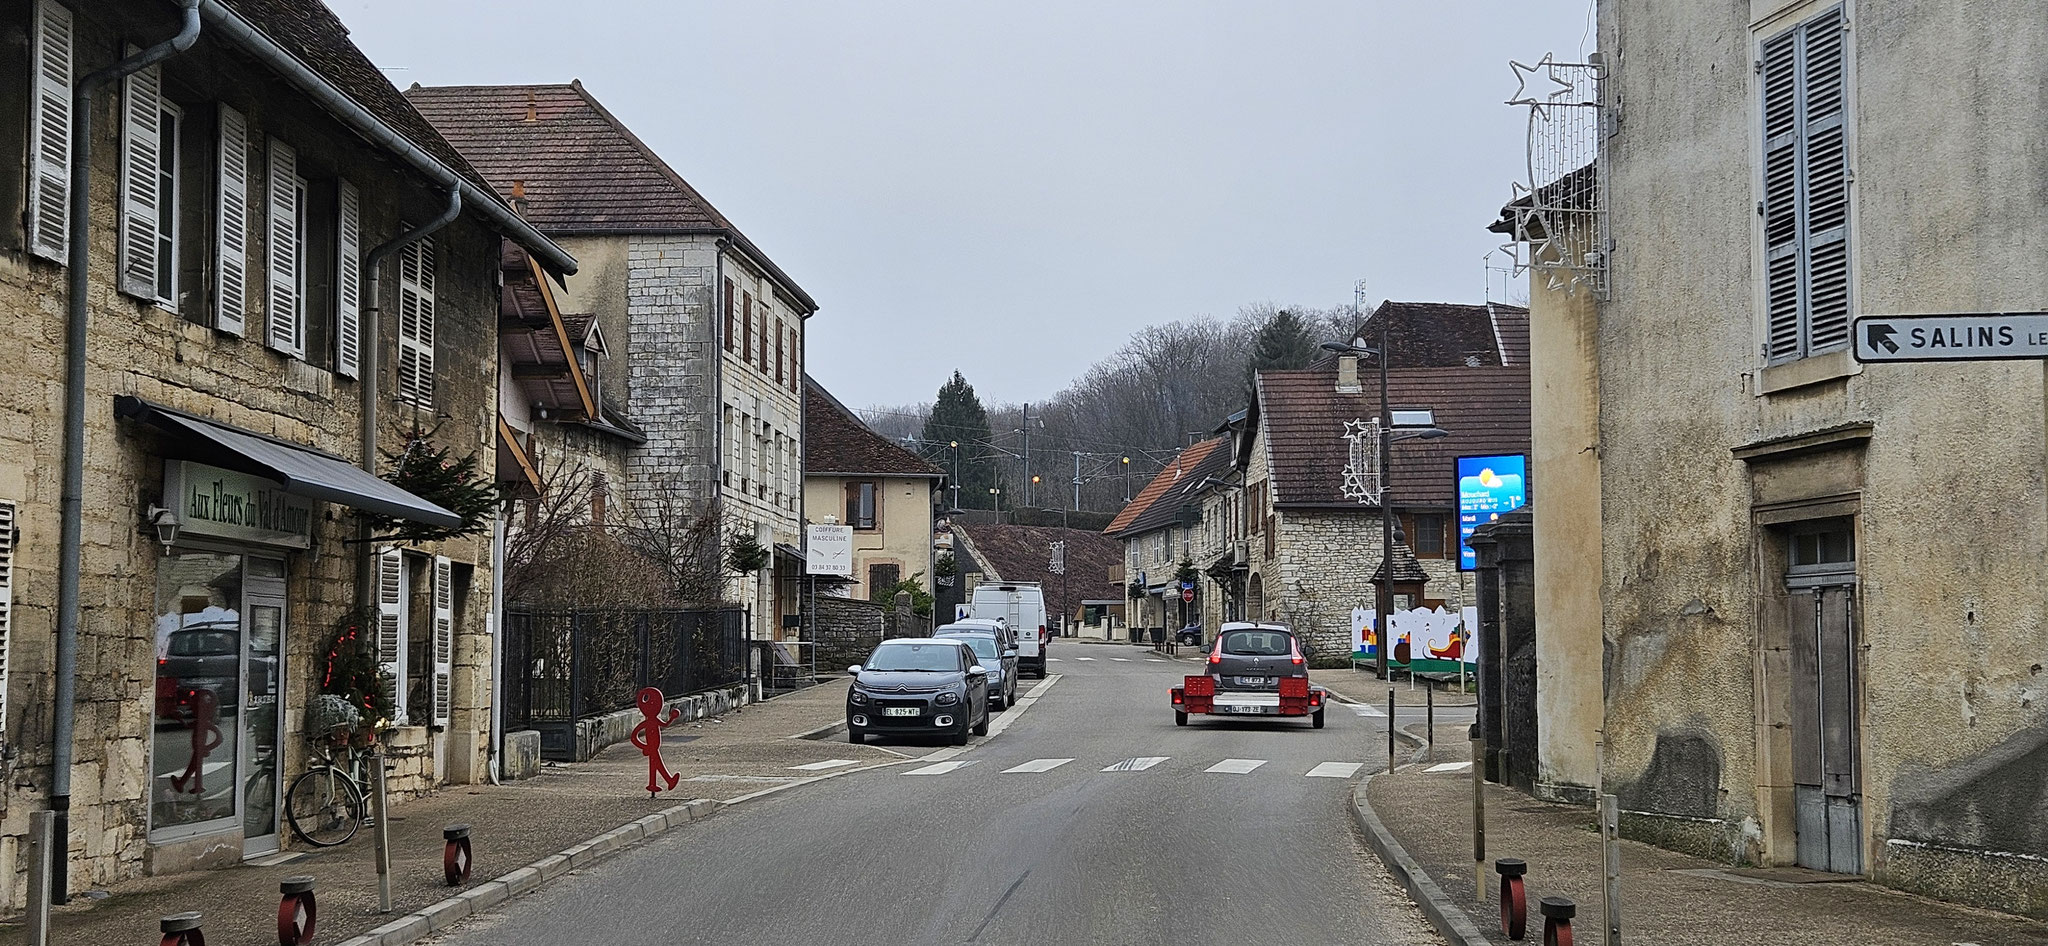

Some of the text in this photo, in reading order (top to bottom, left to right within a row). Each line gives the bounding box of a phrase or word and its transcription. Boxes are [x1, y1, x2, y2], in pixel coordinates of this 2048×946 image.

[1911, 326, 2014, 349] SALINS
[189, 478, 309, 535] Aux Fleurs du Val d'Amour
